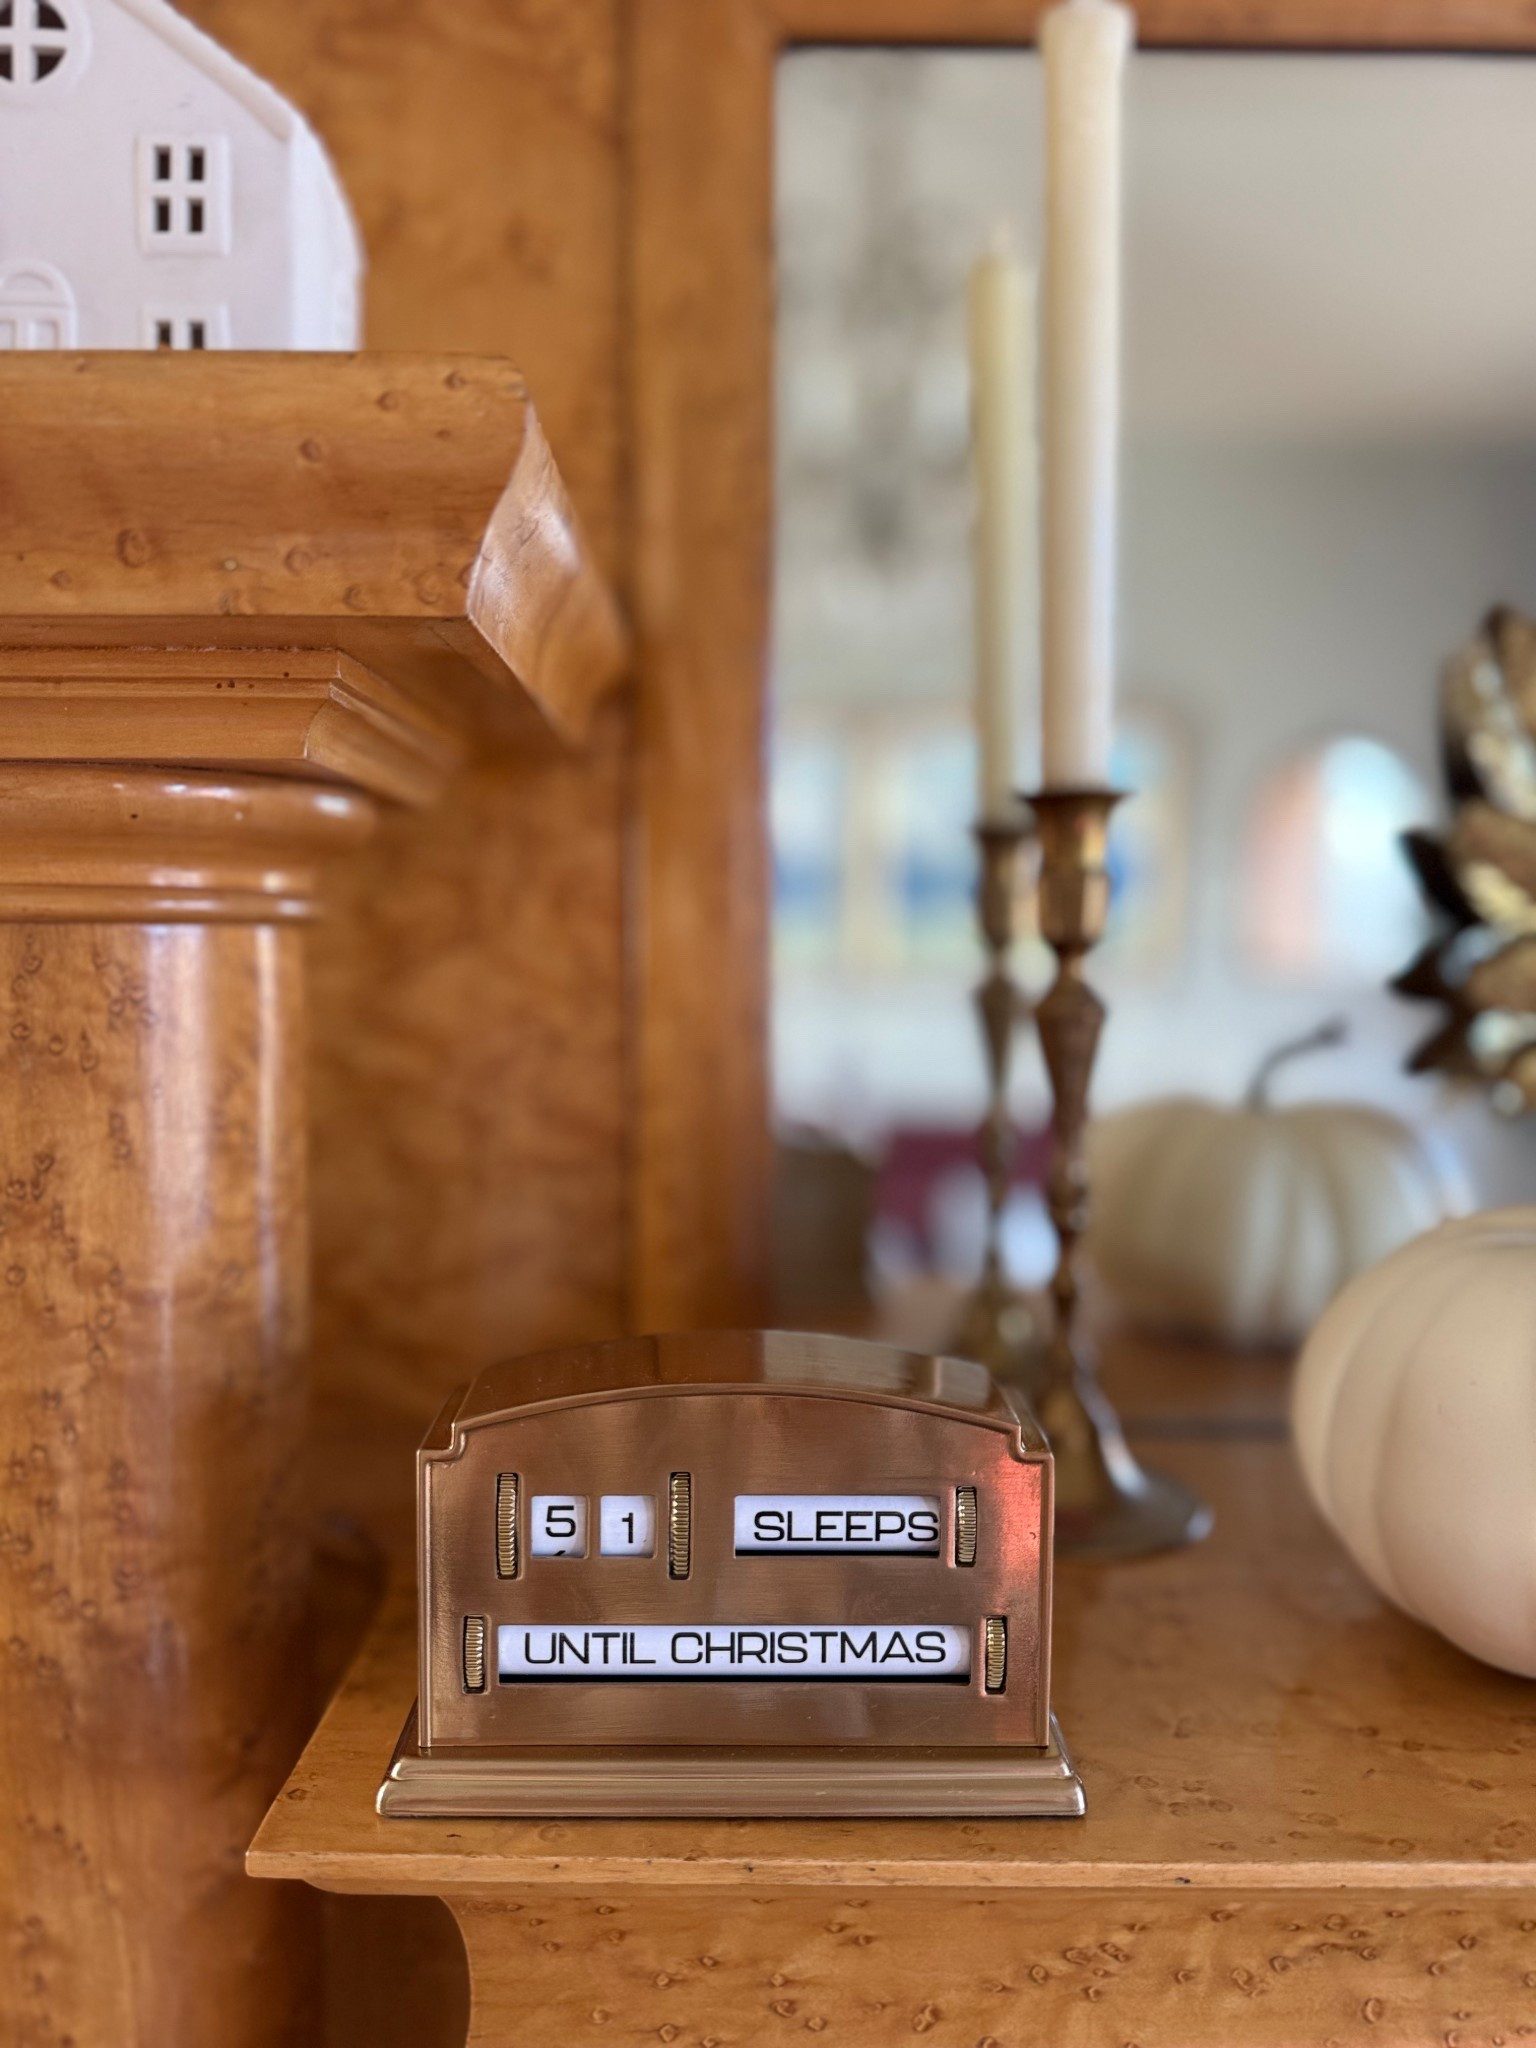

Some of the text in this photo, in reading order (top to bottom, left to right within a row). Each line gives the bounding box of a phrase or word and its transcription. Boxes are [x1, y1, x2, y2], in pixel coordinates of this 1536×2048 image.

[753, 1510, 939, 1542] SLEEPS
[524, 1630, 946, 1665] UNTIL CHRISTMAS
